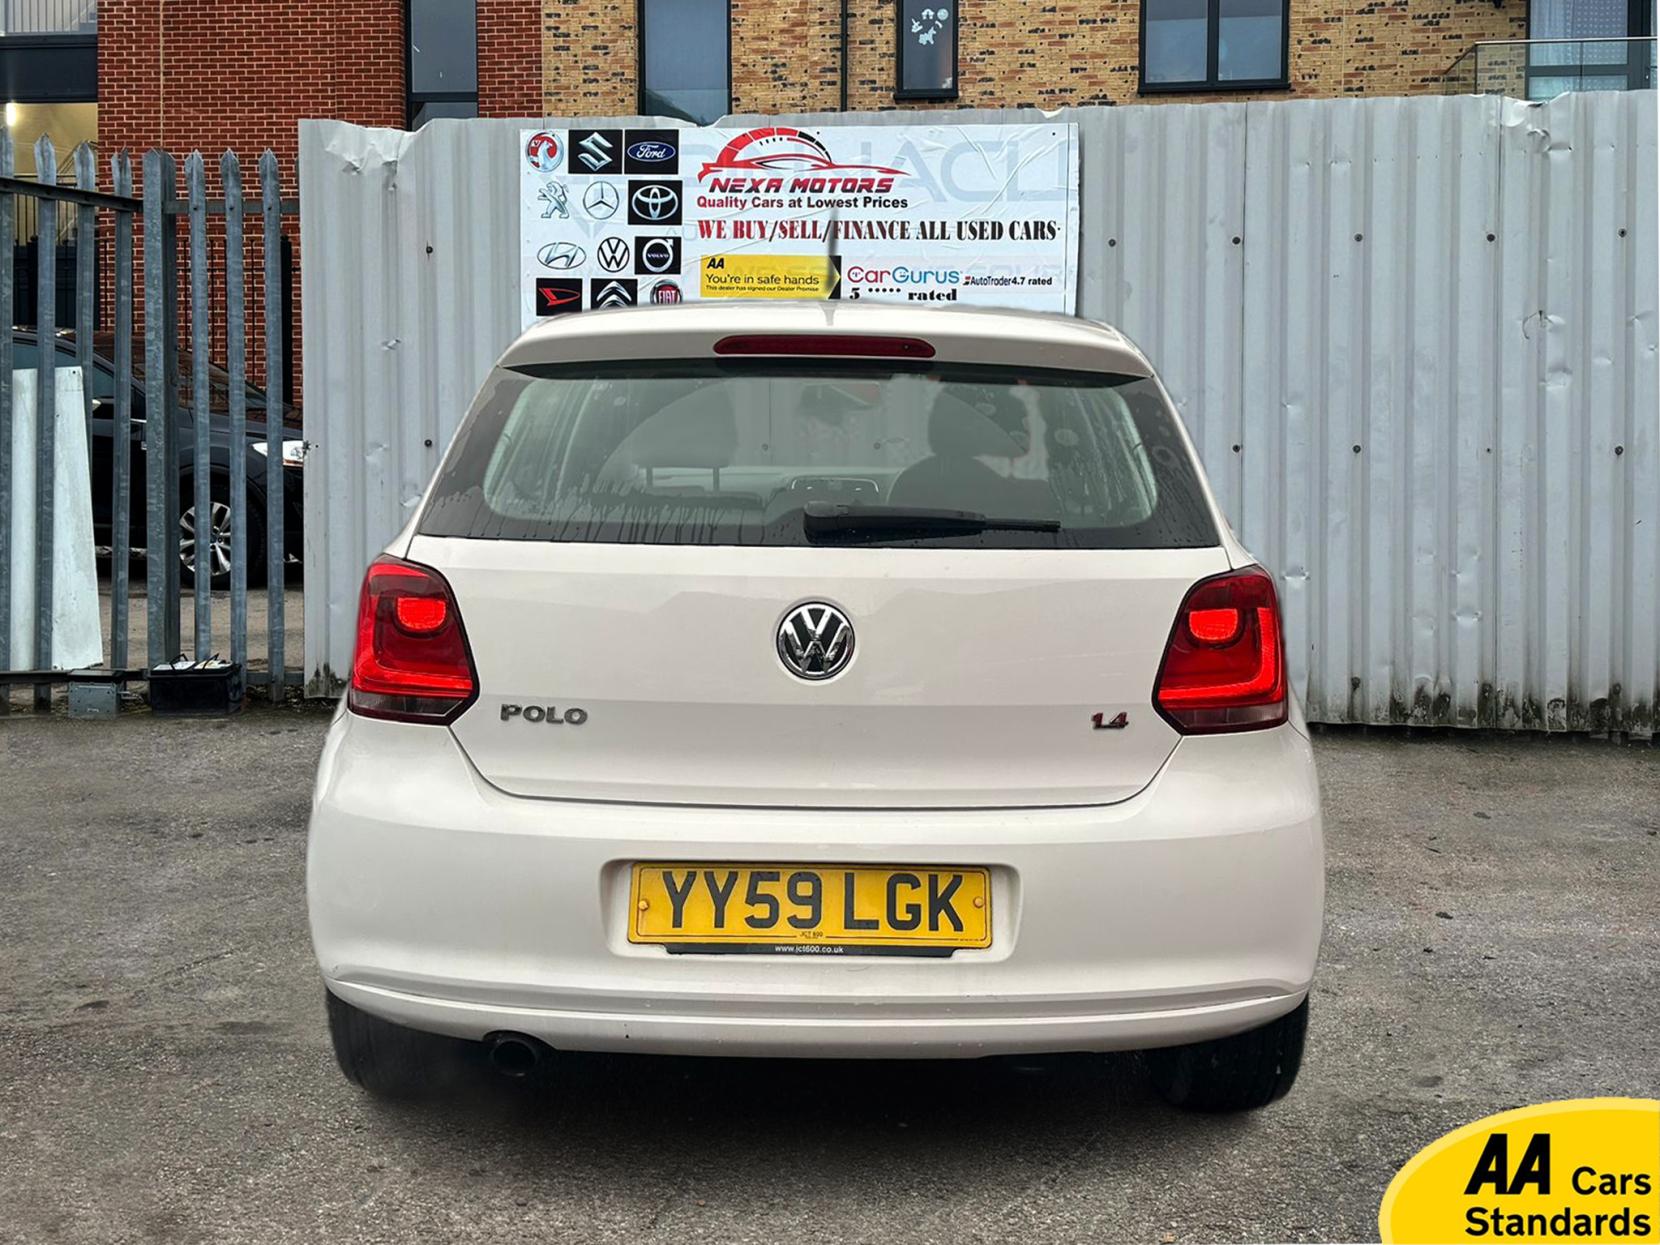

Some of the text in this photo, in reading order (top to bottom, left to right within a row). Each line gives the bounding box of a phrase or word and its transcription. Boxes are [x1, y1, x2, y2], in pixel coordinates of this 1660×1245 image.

[636, 144, 666, 158] Ford
[709, 177, 894, 193] NEXA MOTORS
[697, 196, 908, 210] Quality Cars at Lowest Prices
[697, 220, 727, 239] WE
[916, 221, 950, 240] ALL
[956, 221, 1004, 240] USED
[1009, 221, 1056, 240] CARS
[707, 258, 725, 269] AA
[706, 273, 819, 285] You're in safe hands
[847, 266, 960, 283] CarGurus
[1028, 277, 1052, 285] rated
[849, 288, 957, 300] 5 rated
[500, 703, 588, 725] POLO
[662, 871, 964, 932] YY59 LGK
